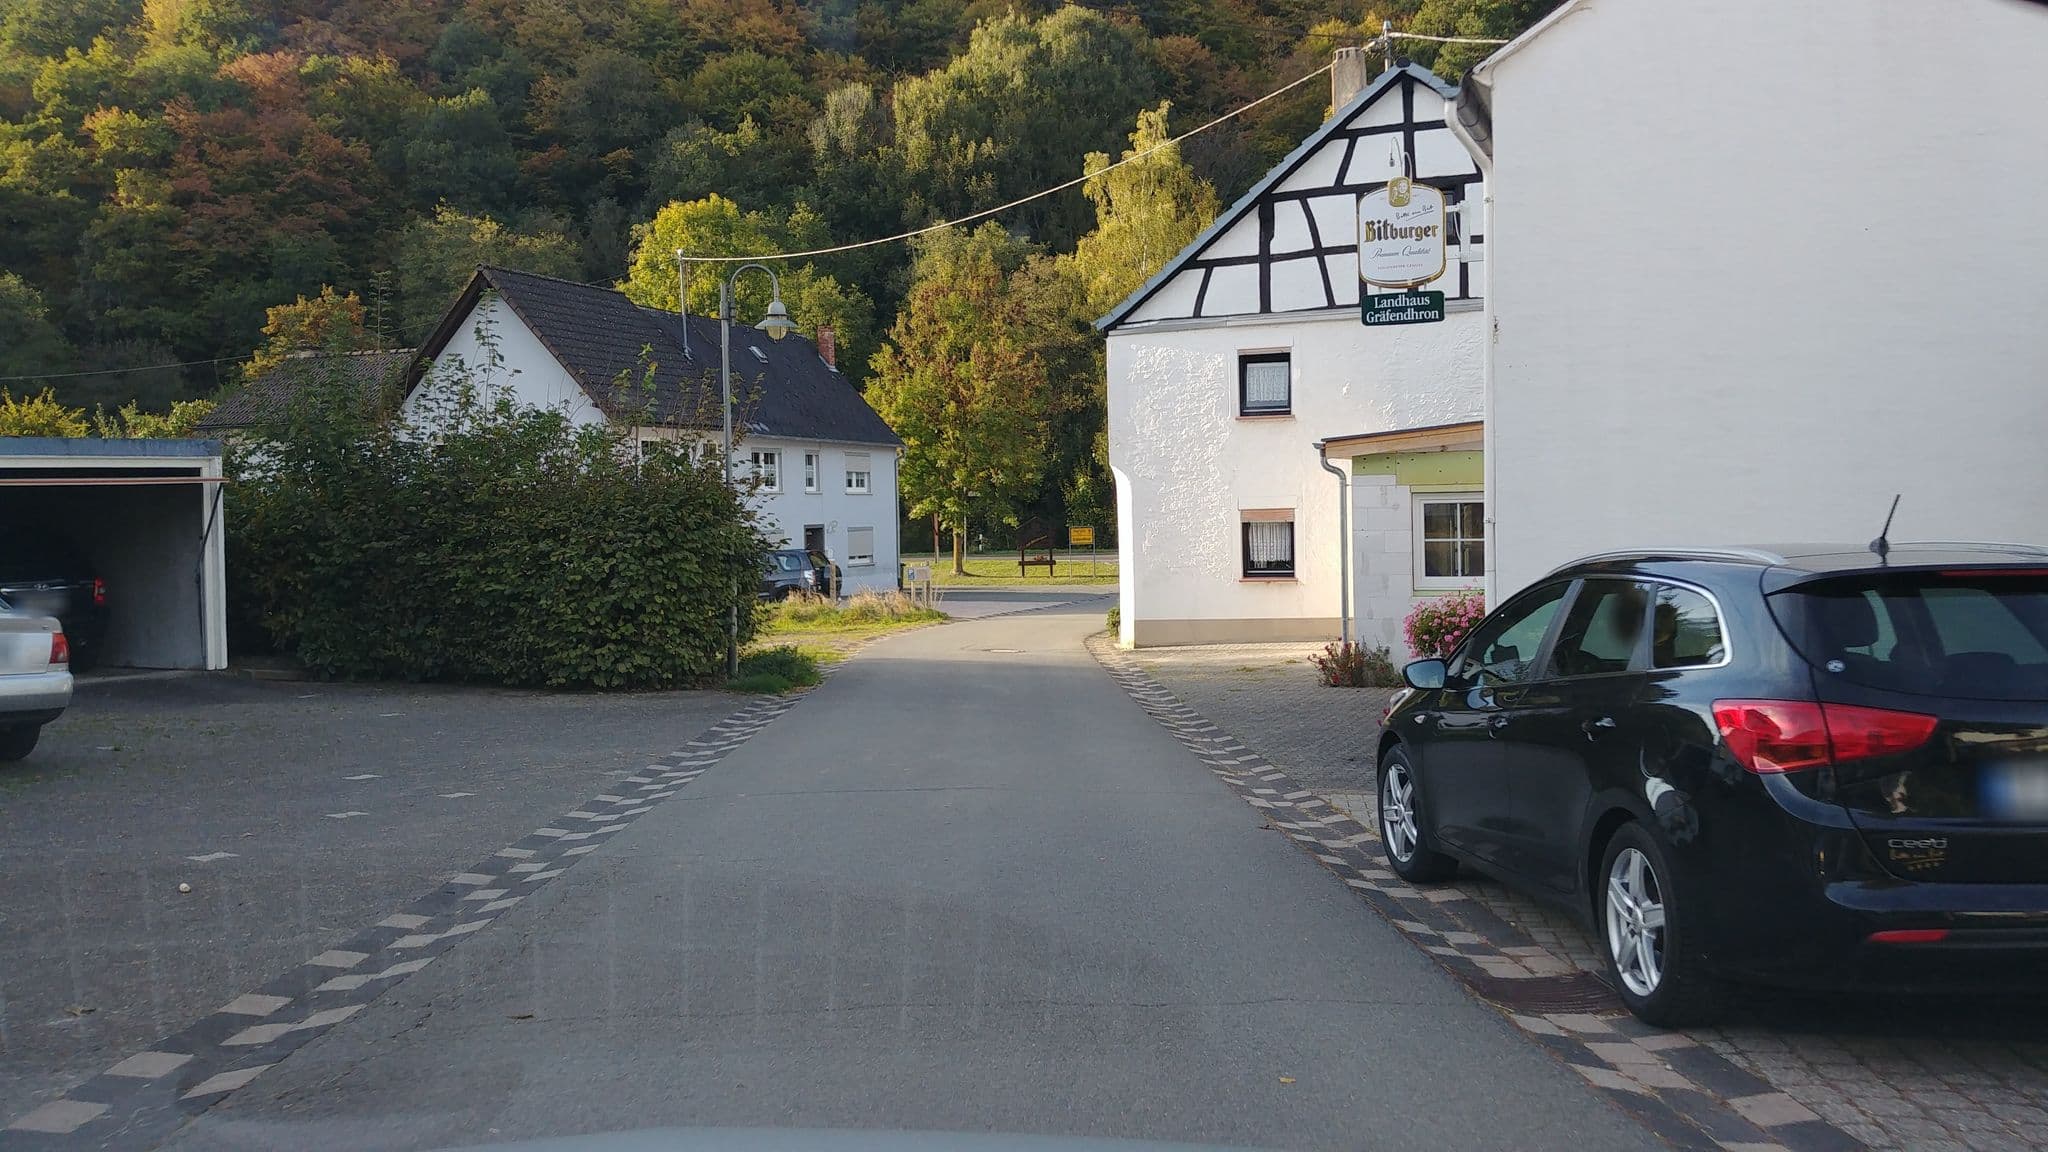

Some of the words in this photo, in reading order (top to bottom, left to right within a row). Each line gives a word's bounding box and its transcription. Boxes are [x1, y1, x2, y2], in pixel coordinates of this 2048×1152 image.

[1364, 218, 1439, 242] Bitburger
[1374, 294, 1430, 309] Landhaus
[1366, 308, 1439, 324] Gräfendhron
